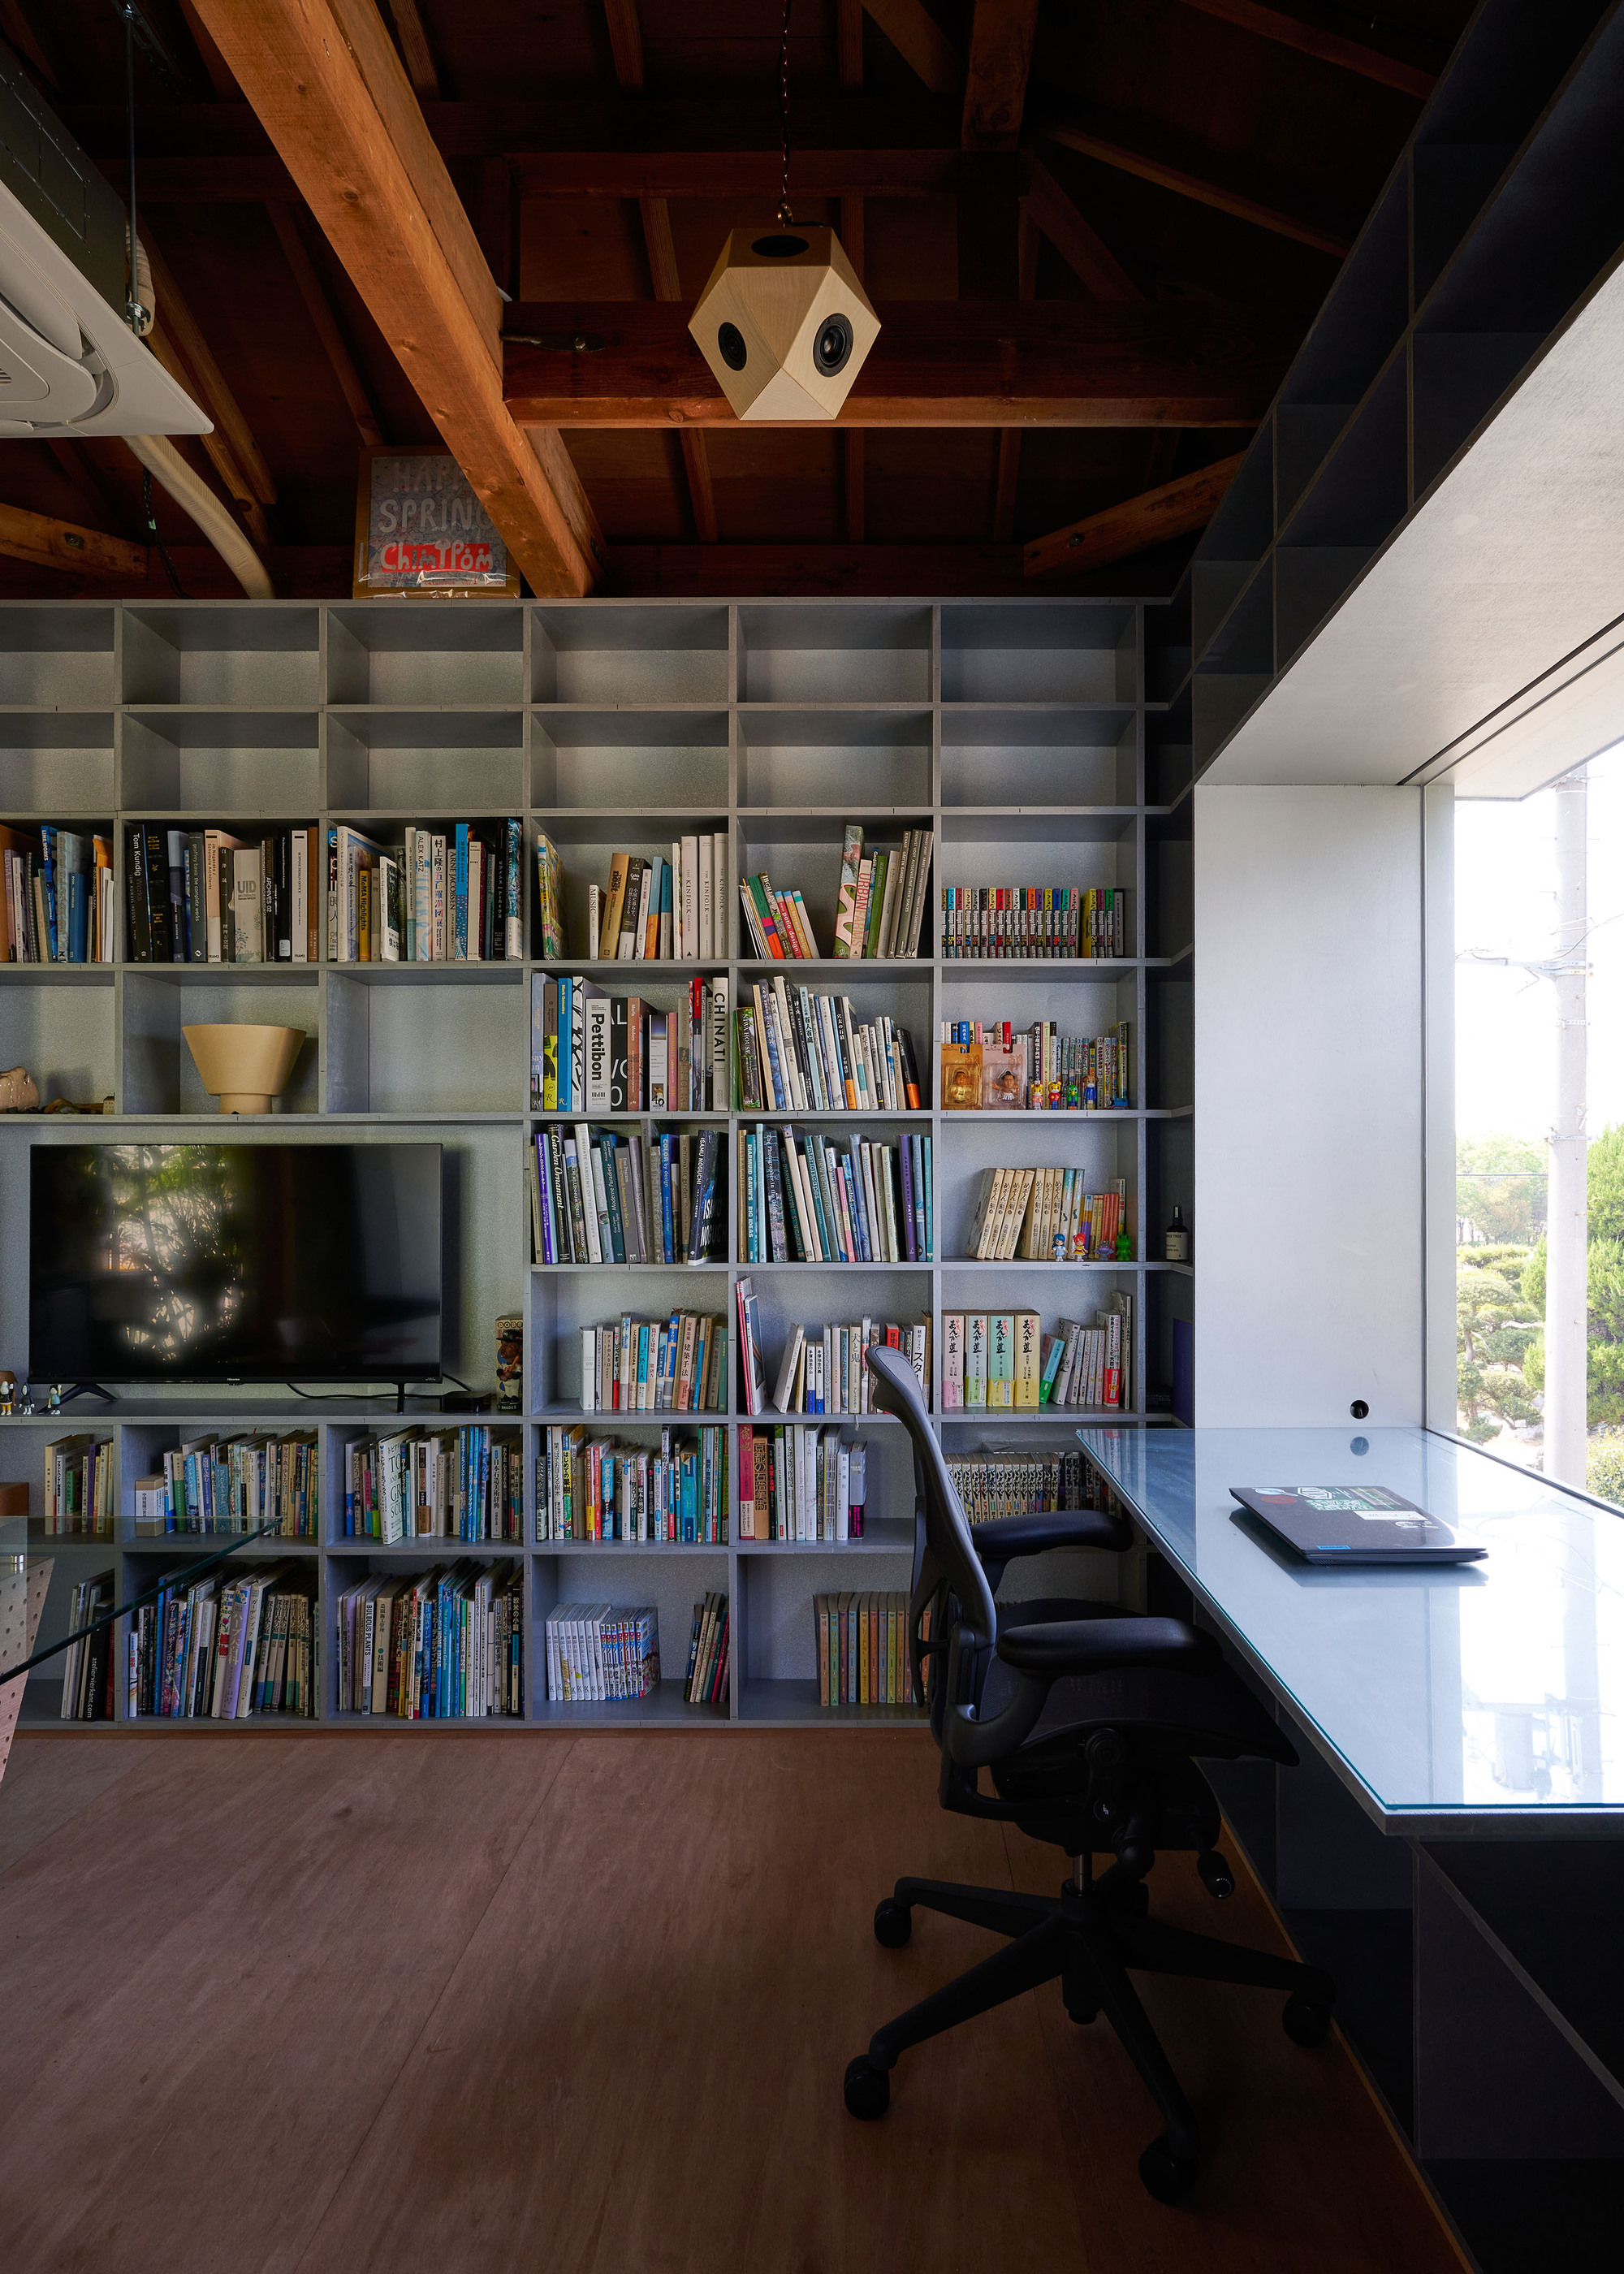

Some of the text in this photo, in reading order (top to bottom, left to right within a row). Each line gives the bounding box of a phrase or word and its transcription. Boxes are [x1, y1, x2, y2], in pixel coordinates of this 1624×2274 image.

[133, 850, 142, 876] Kundig
[237, 880, 257, 894] UID
[266, 905, 272, 913] 02
[361, 898, 369, 931] Highlights
[782, 911, 800, 953] patio design
[790, 910, 808, 953] terrace design
[714, 992, 725, 1062] CHINATI
[591, 1014, 606, 1081] Pettibon
[743, 1032, 751, 1055] HOUSE
[551, 1135, 564, 1209] Garden Ornament
[696, 1156, 705, 1185] NOGUCHI
[806, 1144, 819, 1200] Interiorscapes
[819, 1174, 828, 1191] tech
[827, 1152, 837, 1184] Courtyard
[596, 1185, 604, 1208] garden
[822, 1191, 832, 1217] garden
[948, 1319, 960, 1354] まんが道
[973, 1319, 982, 1354] まんが道
[996, 1319, 1006, 1354] まんが道
[1022, 1319, 1033, 1354] まんが道
[682, 1343, 691, 1377] 建築手法
[983, 1501, 987, 1511] 5
[990, 1501, 996, 1511] 11
[998, 1501, 1004, 1511] 12
[1006, 1501, 1013, 1511] 13
[1013, 1501, 1020, 1511] 14
[1021, 1501, 1027, 1511] 15
[1028, 1501, 1035, 1511] 16
[228, 1614, 243, 1666] ハーブ大百科
